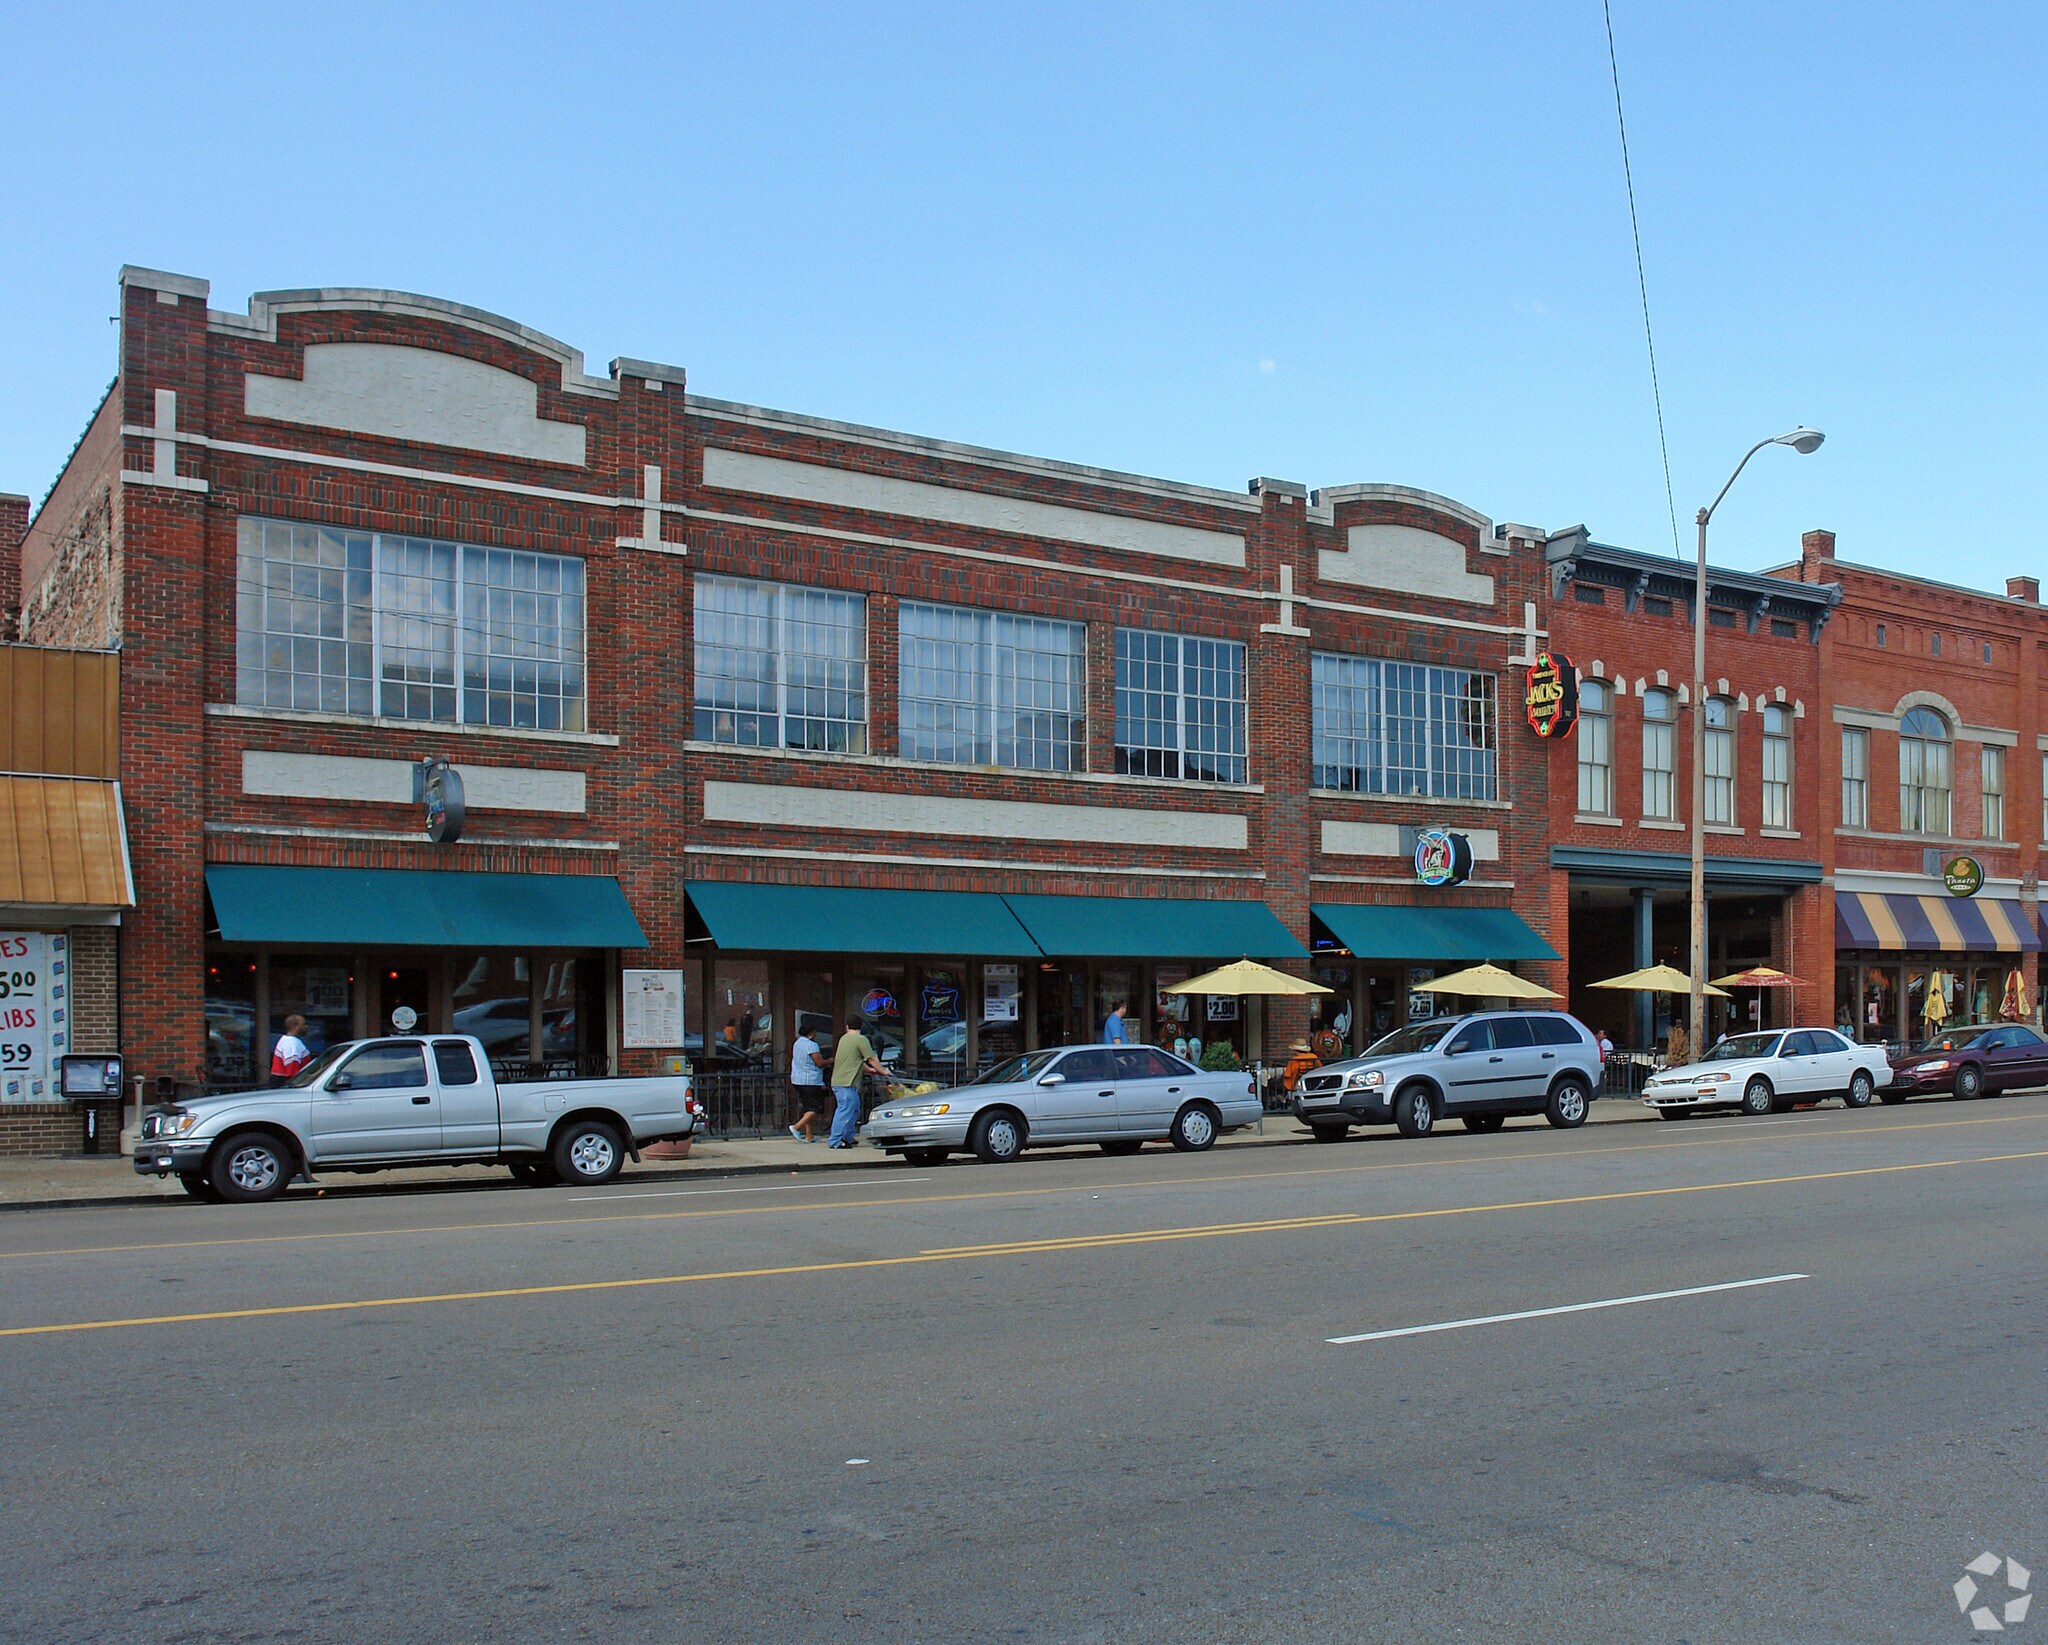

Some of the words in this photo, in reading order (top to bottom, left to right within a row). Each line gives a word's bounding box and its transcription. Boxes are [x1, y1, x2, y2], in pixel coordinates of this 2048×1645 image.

[0, 936, 28, 959] ES
[0, 1008, 36, 1030] IBS
[1208, 1001, 1235, 1015] $2.00
